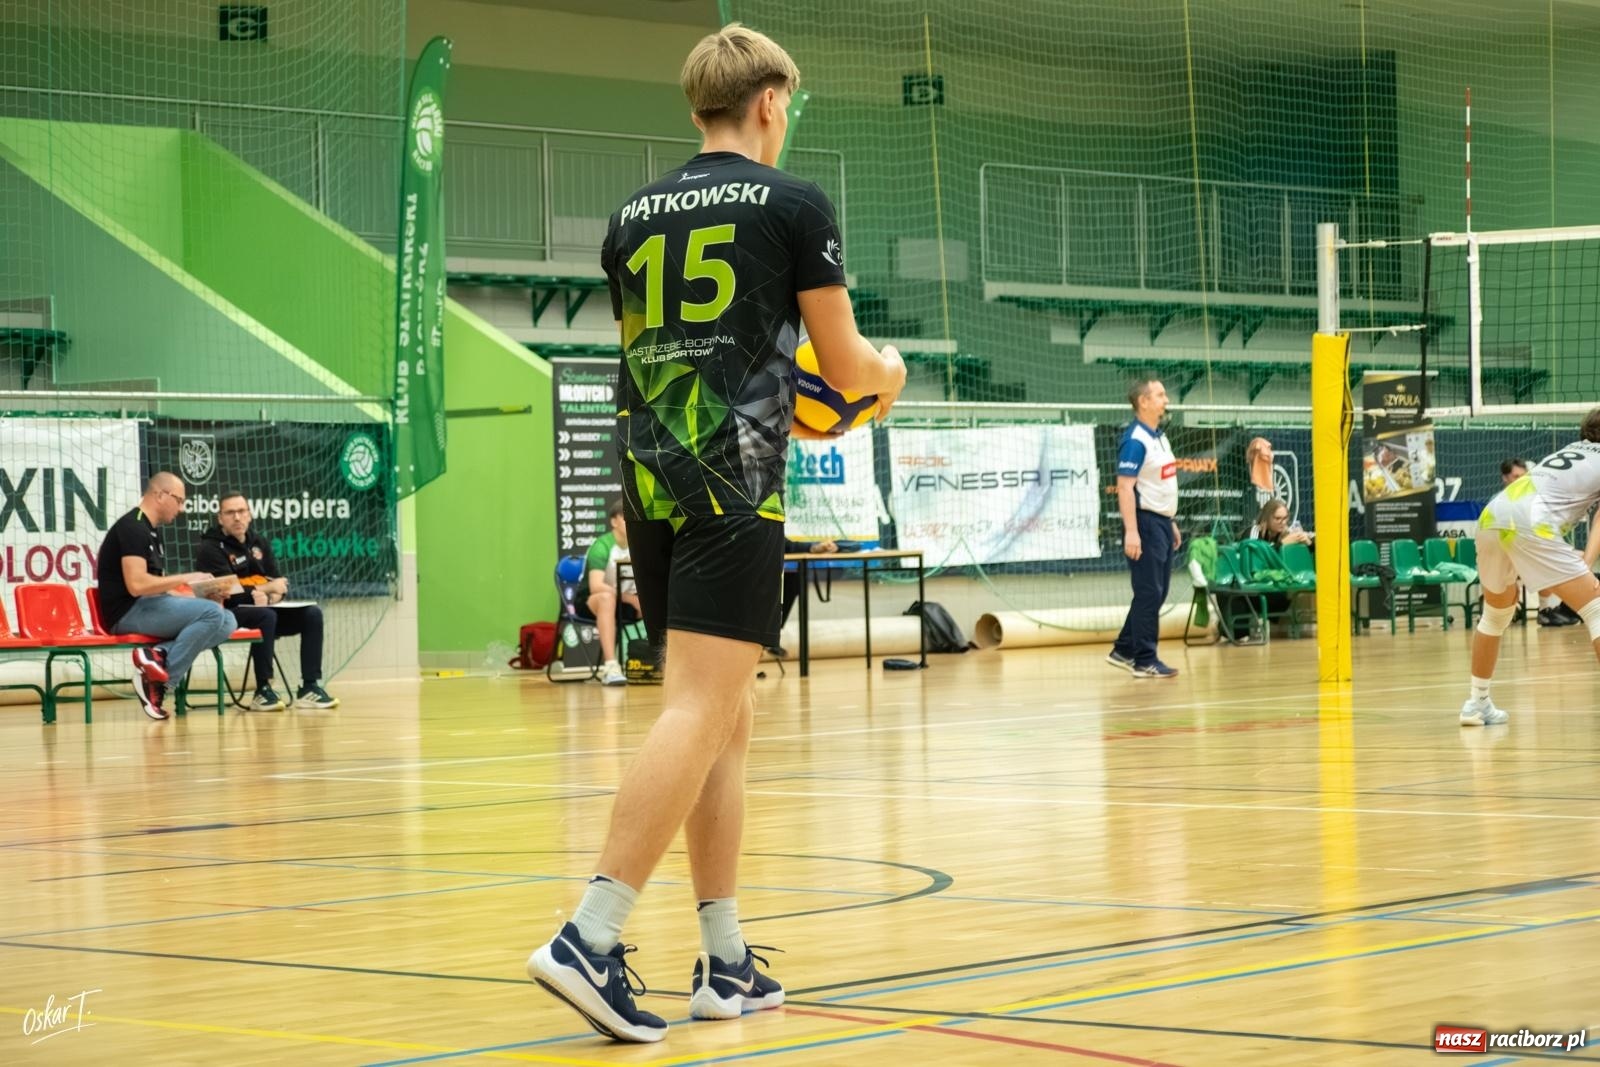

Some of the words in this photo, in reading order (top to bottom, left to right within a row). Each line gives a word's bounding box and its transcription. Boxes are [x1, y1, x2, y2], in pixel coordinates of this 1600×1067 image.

[620, 183, 770, 226] PIĄTKOWSKI
[625, 224, 736, 329] 15
[900, 470, 1041, 492] VANESSA
[1050, 469, 1089, 486] FM
[247, 490, 350, 526] wspiera
[0, 543, 99, 583] LOGY
